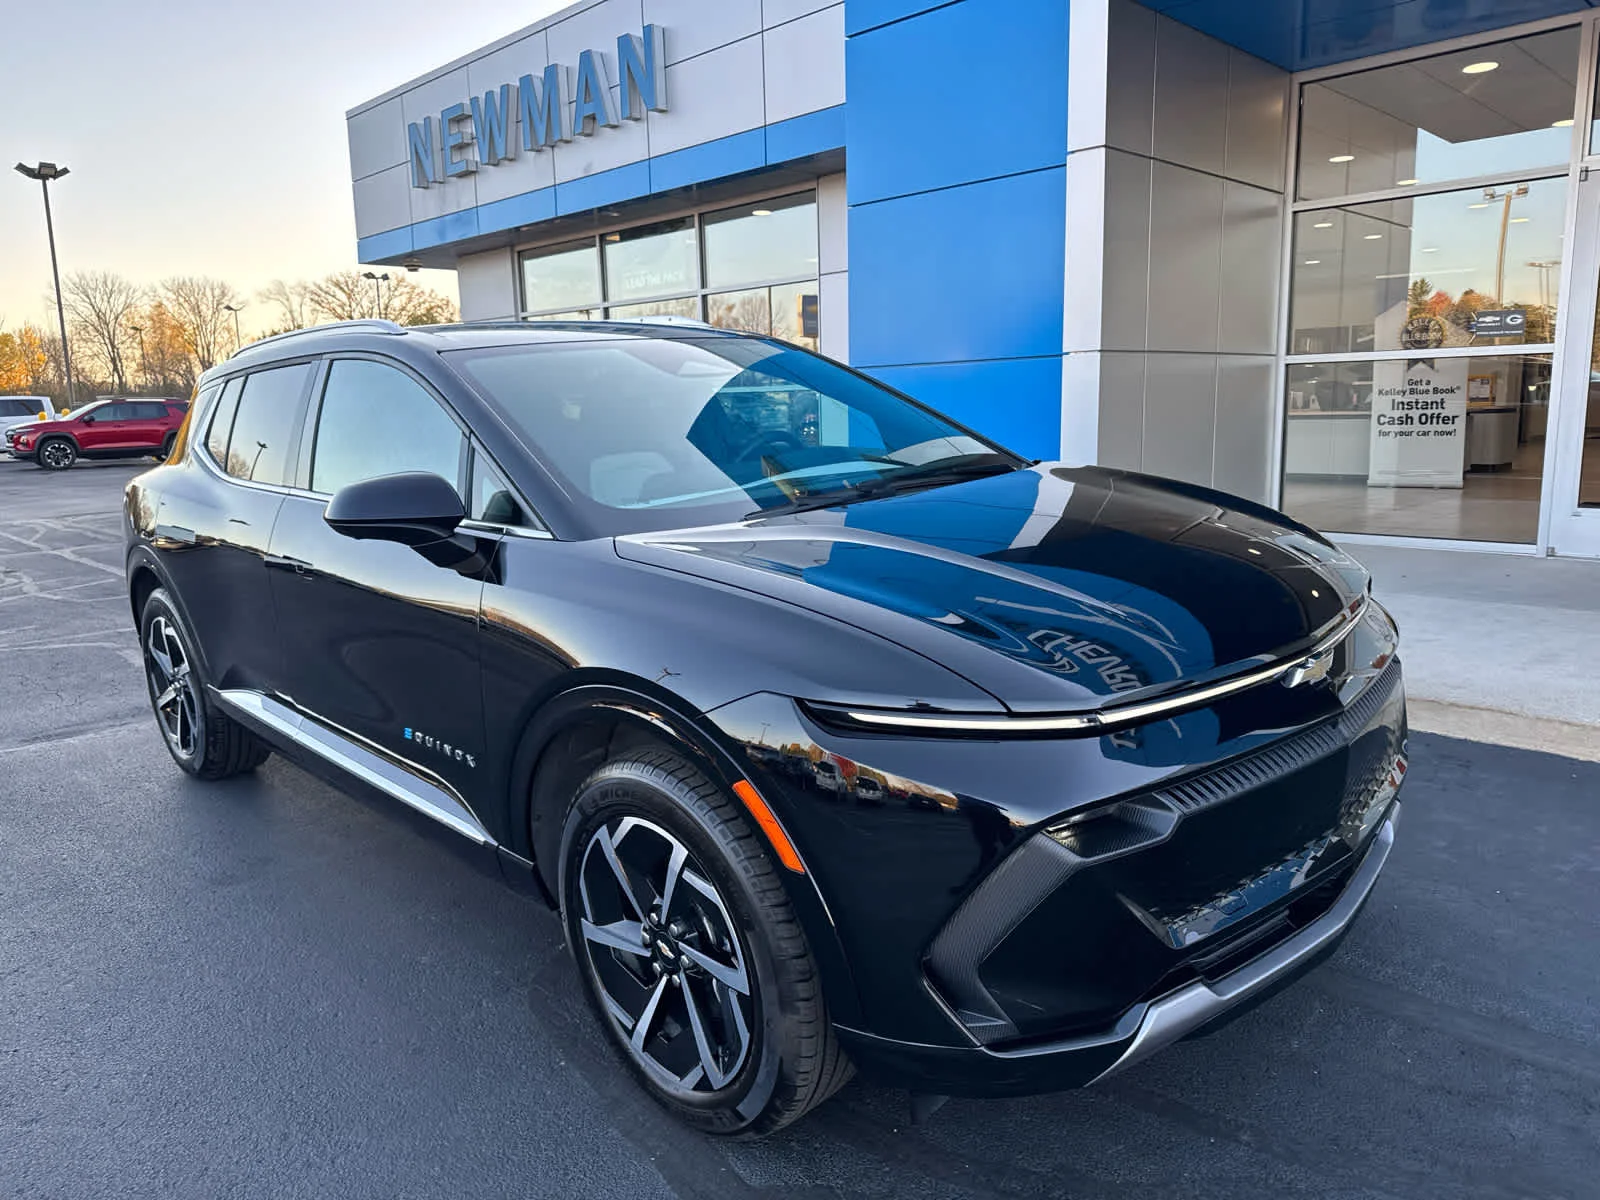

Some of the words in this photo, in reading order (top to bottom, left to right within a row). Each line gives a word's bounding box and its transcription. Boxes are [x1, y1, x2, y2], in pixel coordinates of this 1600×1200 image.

[408, 24, 668, 188] NEWMAN
[1407, 378, 1423, 386] Get
[1378, 388, 1407, 397] Kelley
[1409, 387, 1430, 395] Blue
[1391, 398, 1446, 411] Instant
[1377, 413, 1414, 426] Cash
[1418, 412, 1459, 425] Offer
[1378, 429, 1392, 437] for
[1393, 430, 1414, 438] your
[1433, 428, 1457, 437] now!
[403, 727, 476, 768] EQUINOX
